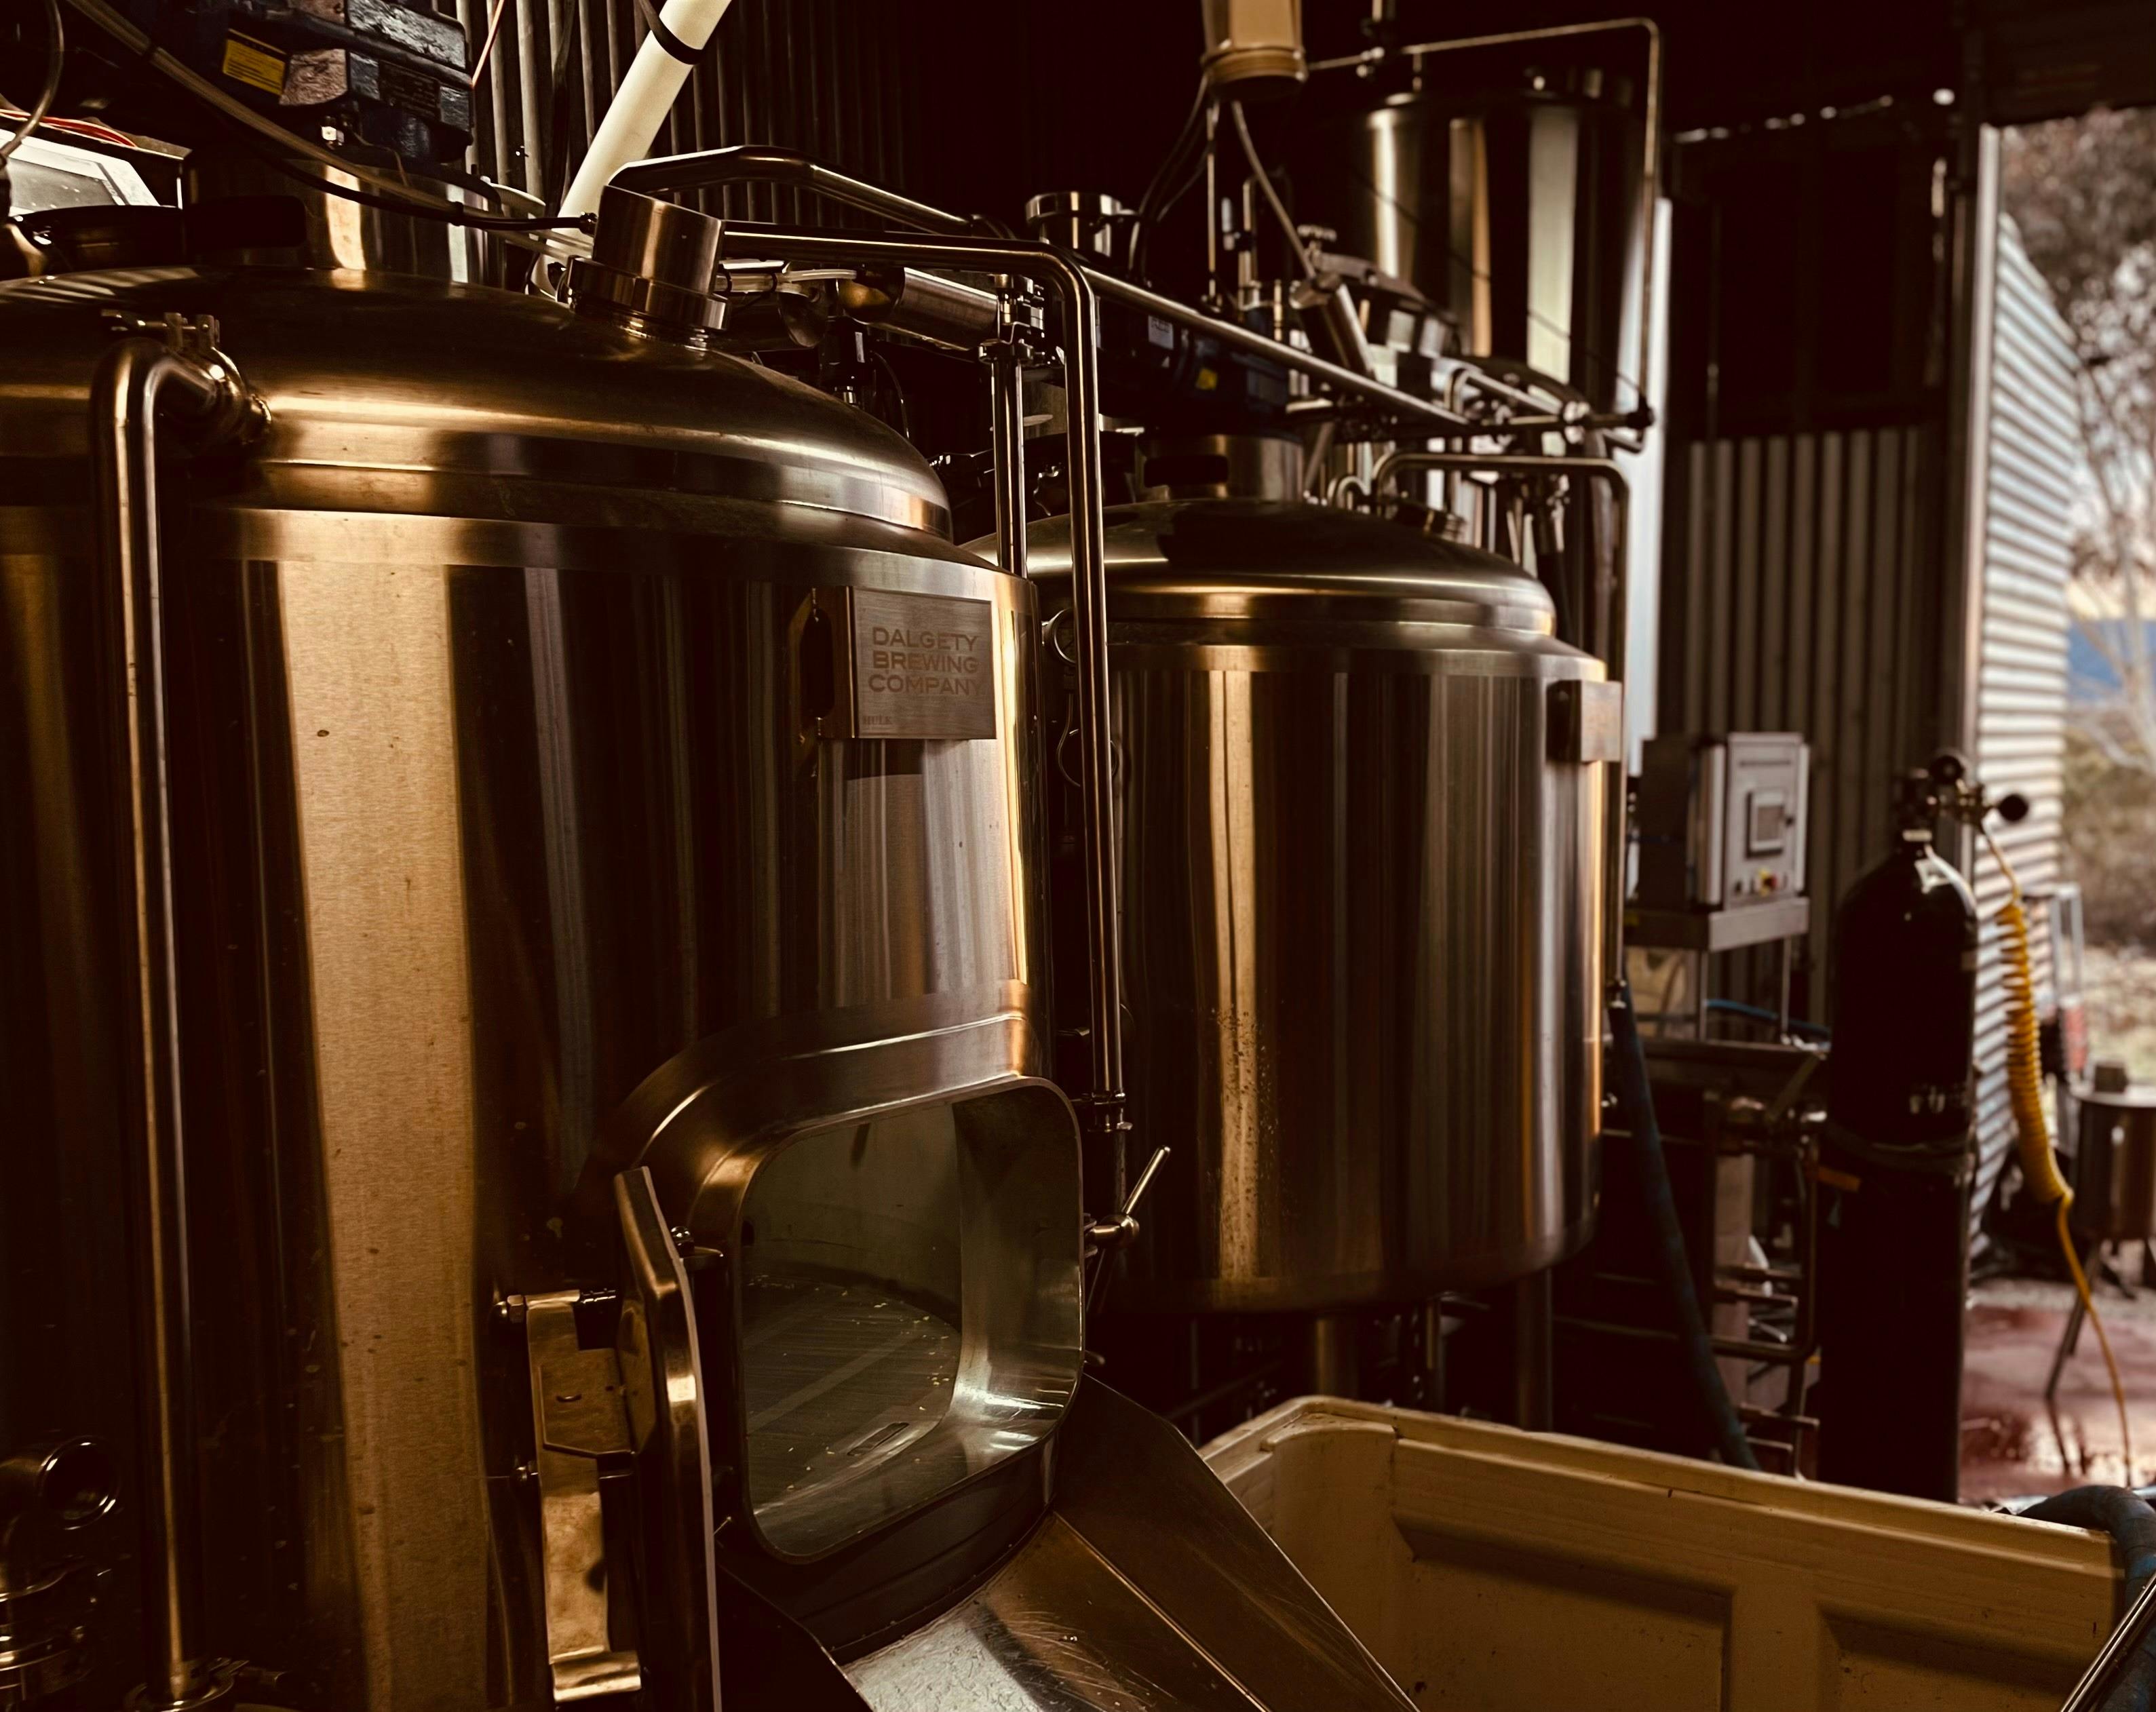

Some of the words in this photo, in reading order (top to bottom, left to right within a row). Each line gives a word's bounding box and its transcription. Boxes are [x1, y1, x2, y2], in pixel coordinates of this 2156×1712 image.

[872, 626, 978, 651] DALGETY
[872, 650, 979, 674] BREWING
[868, 674, 982, 695] COMPANY
